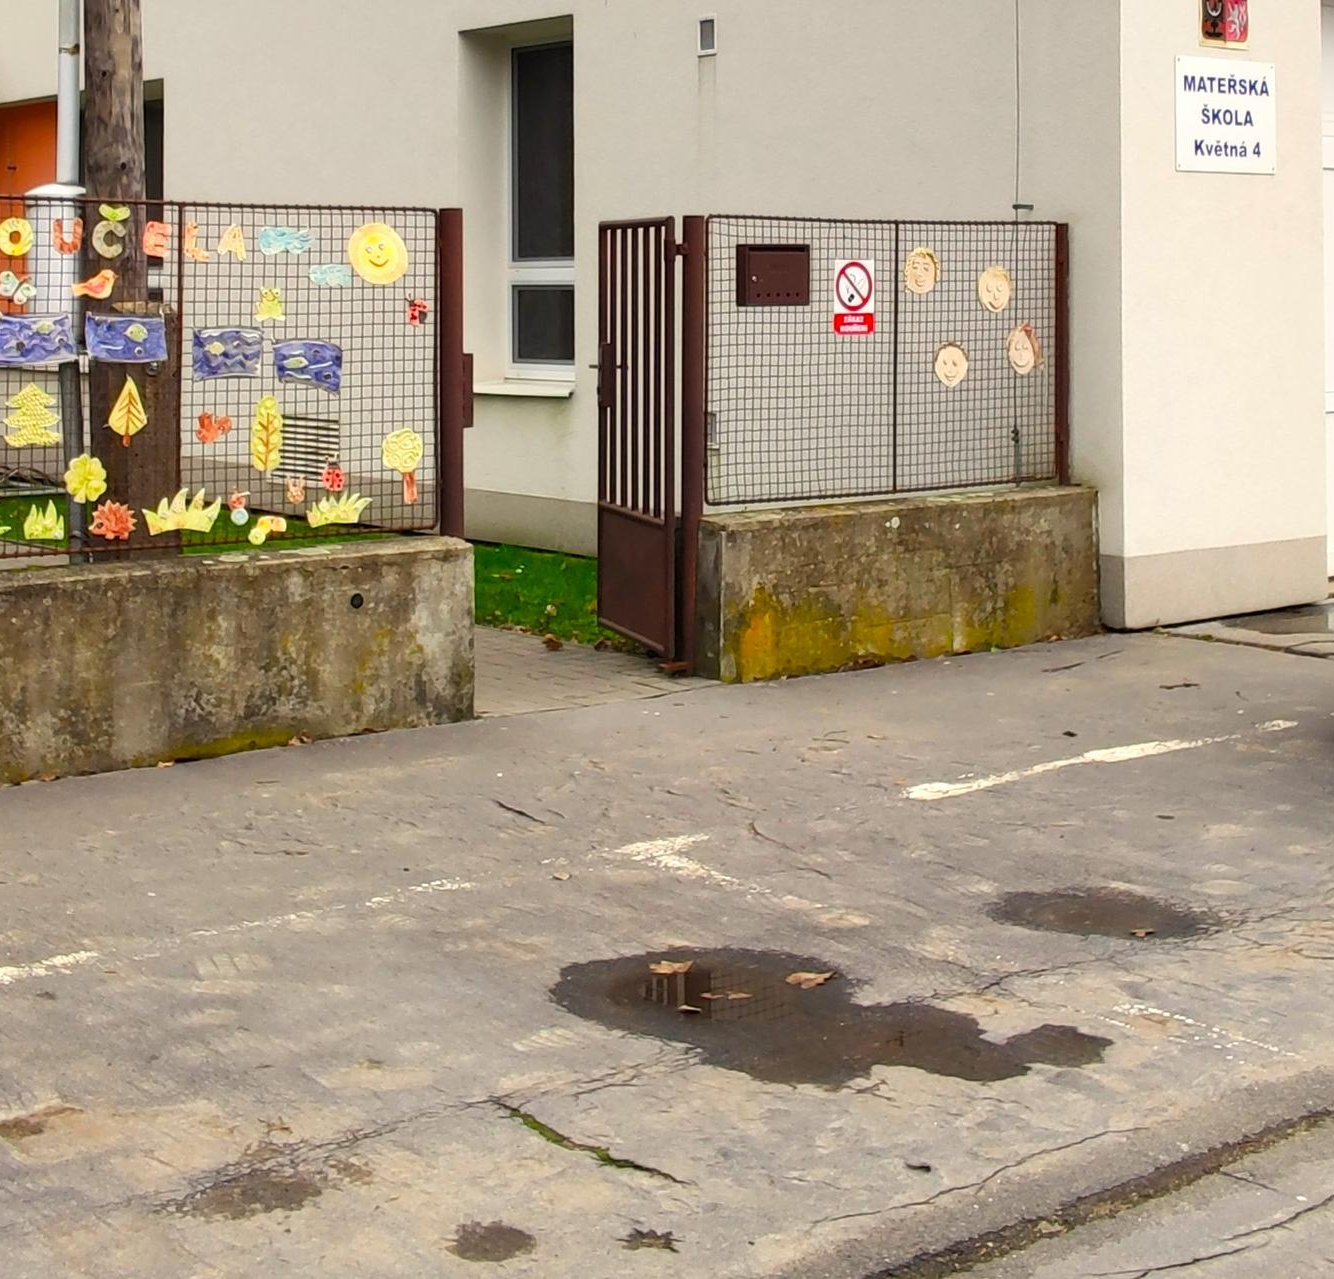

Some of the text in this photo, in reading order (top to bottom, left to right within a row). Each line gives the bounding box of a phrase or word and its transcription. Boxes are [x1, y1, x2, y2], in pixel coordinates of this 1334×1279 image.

[1184, 74, 1269, 96] MATEŘSKÁ
[1201, 104, 1254, 126] ŠKOLA
[1194, 139, 1261, 158] Květná 4
